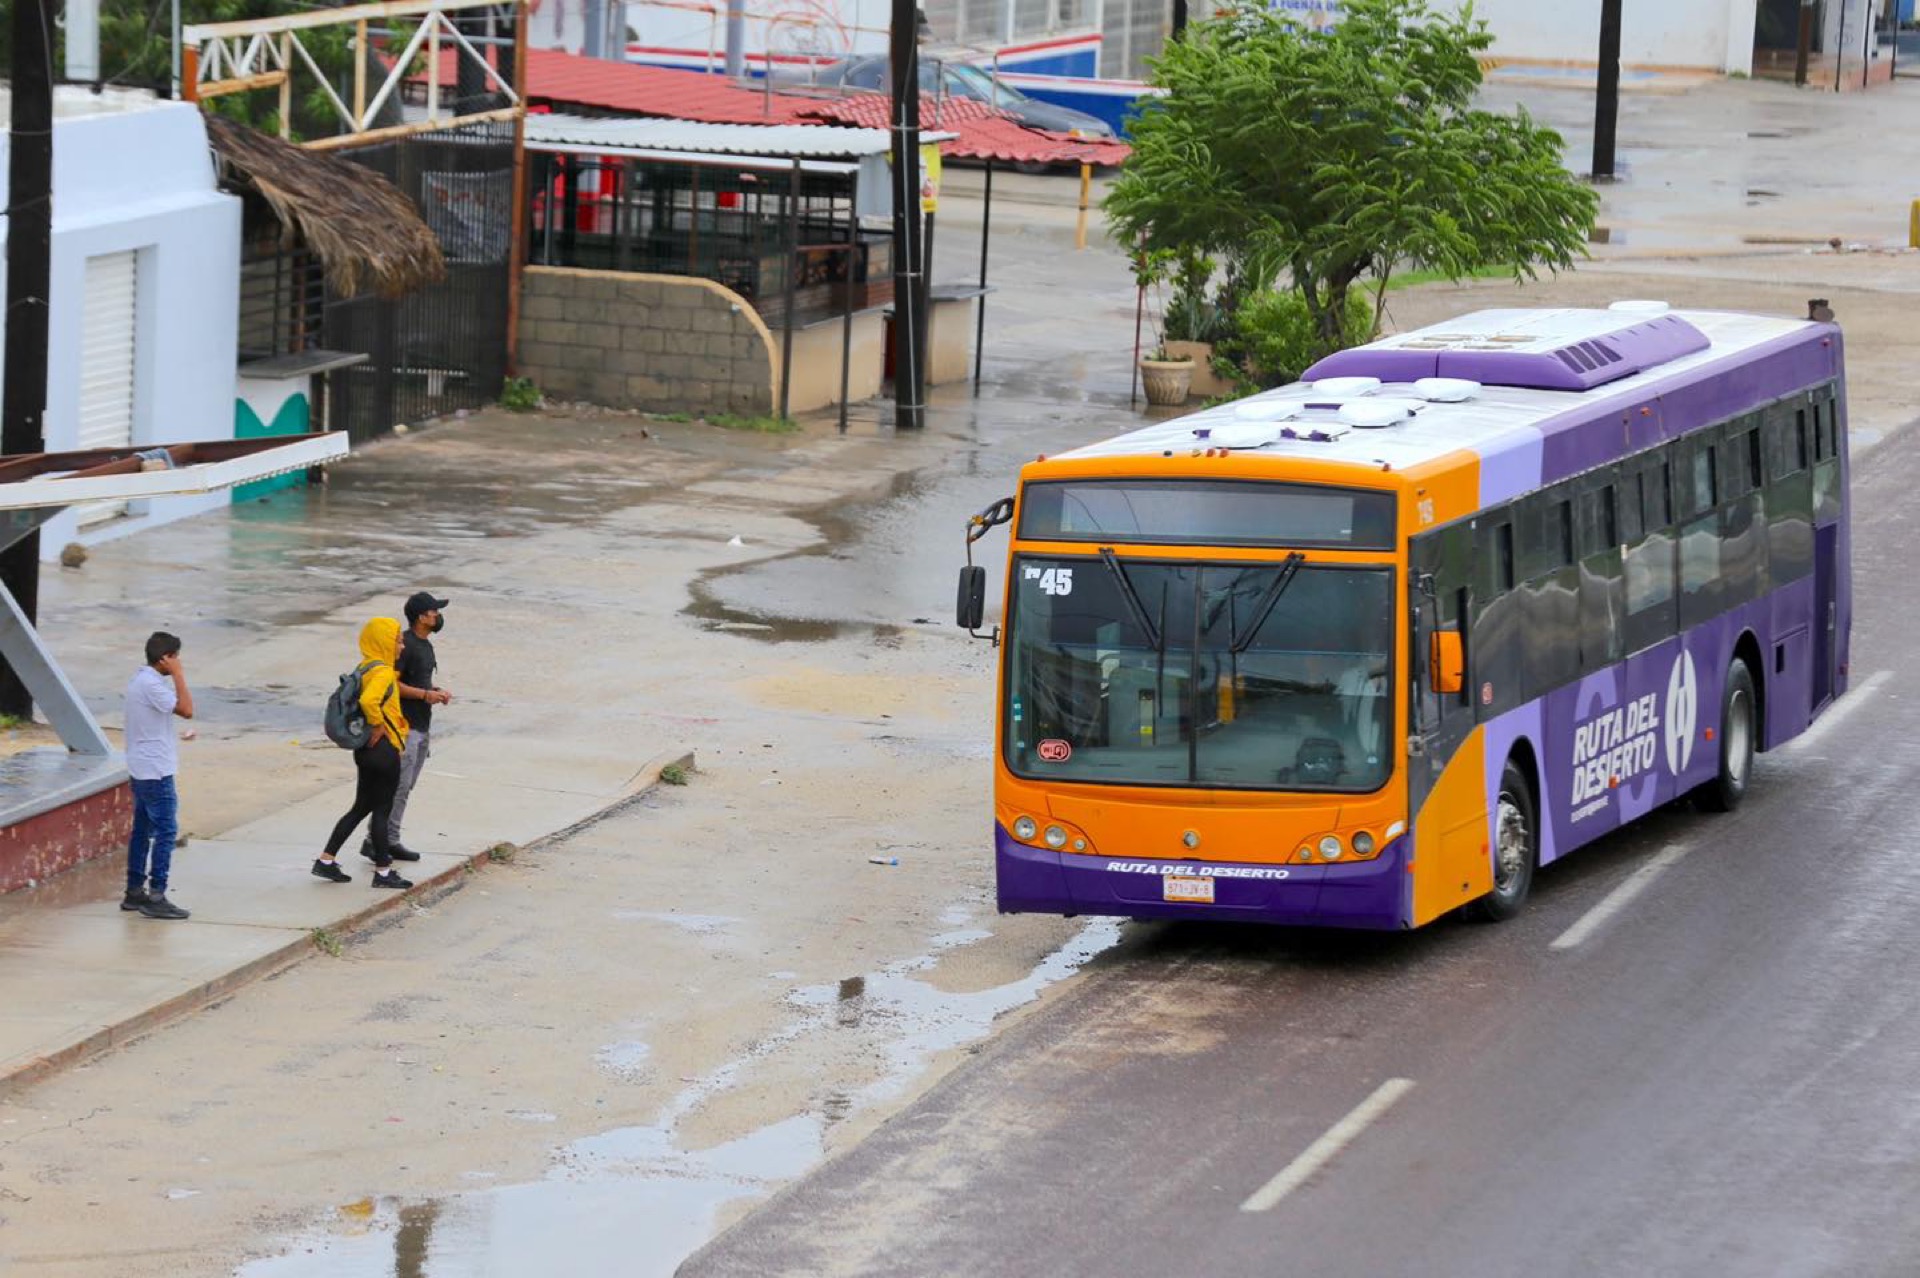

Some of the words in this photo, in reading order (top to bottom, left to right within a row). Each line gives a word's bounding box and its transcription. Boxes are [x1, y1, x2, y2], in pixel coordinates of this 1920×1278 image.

[1572, 707, 1623, 766] RUTA
[1625, 692, 1659, 740] DEL
[1571, 731, 1656, 806] DESIERTO
[1107, 862, 1157, 874] RUTA
[1160, 865, 1197, 876] DEL
[1199, 867, 1290, 879] DESIERTO
